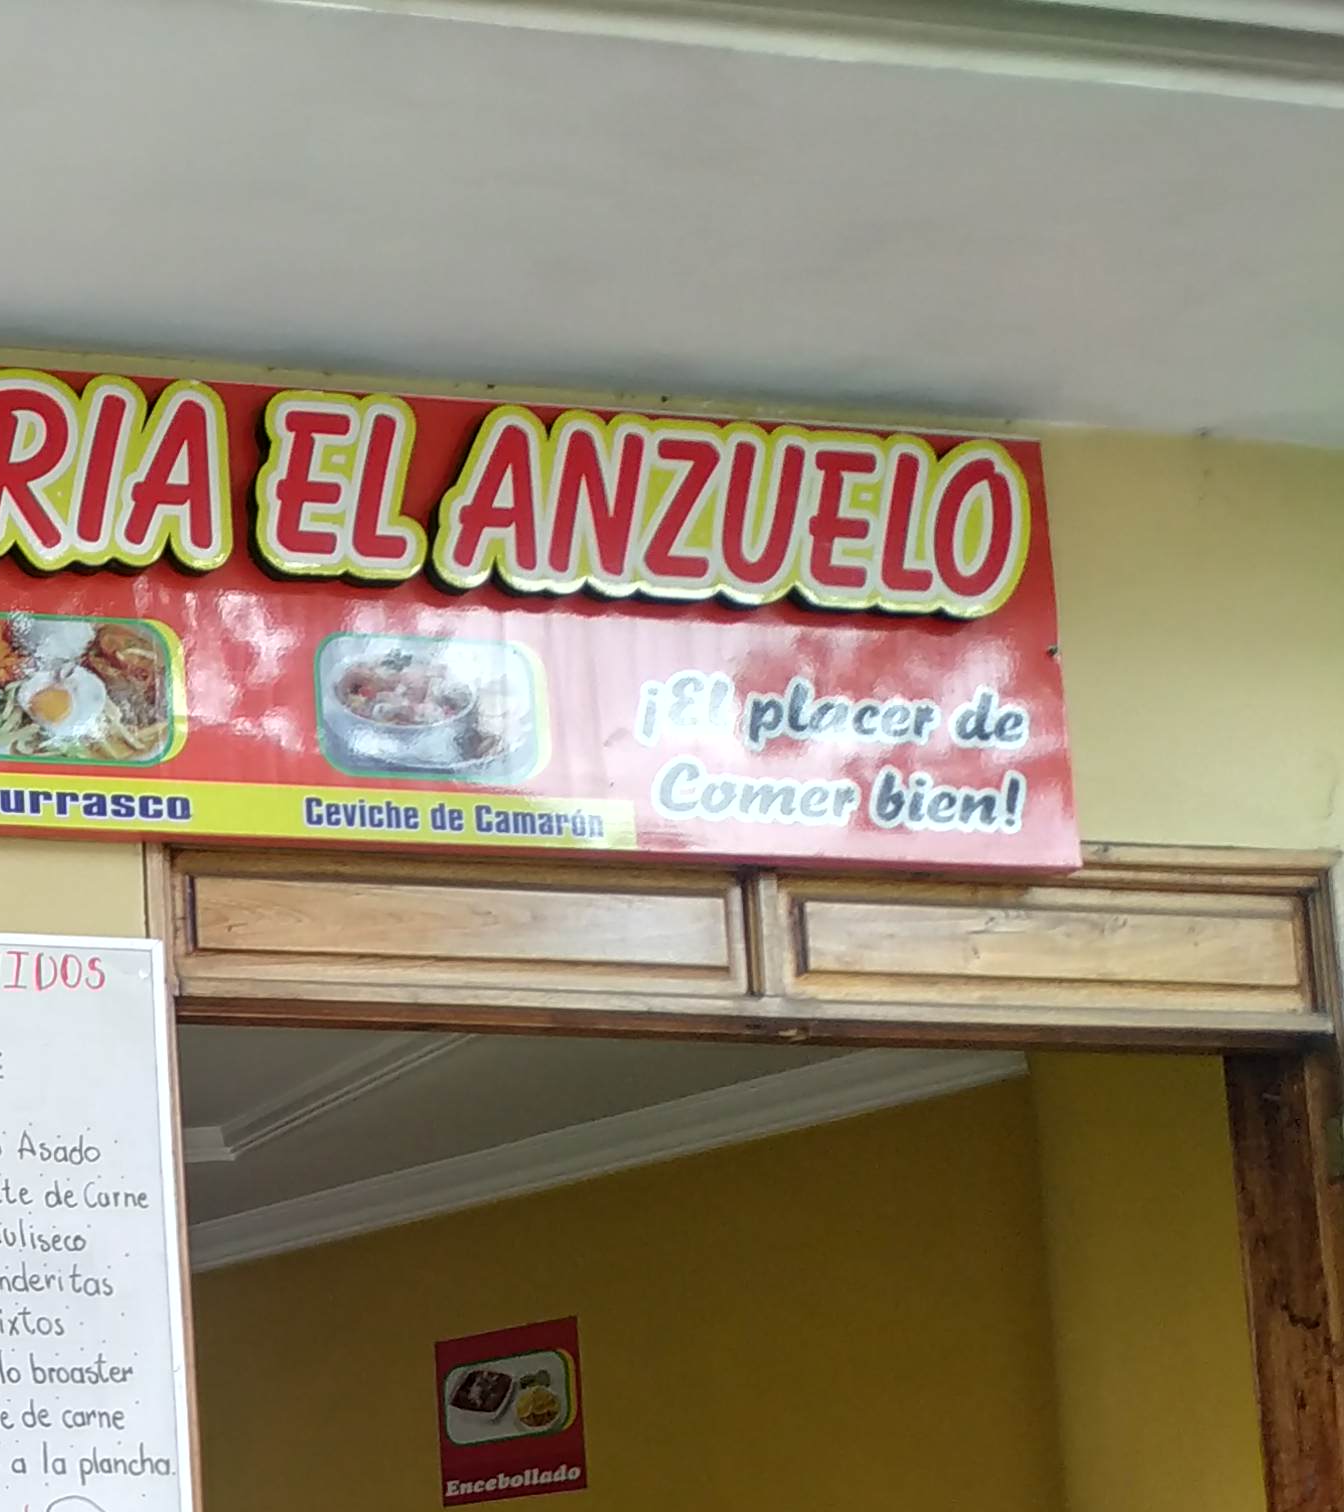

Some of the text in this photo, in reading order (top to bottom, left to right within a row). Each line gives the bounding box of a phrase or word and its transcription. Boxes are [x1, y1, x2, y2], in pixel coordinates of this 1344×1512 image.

[257, 400, 419, 570] EL
[442, 410, 1024, 607] ANZUELO
[749, 690, 944, 753] placer
[954, 700, 1027, 748] de
[654, 762, 1025, 832] Comer bien!
[304, 796, 605, 838] Ceviche de Camarón
[17, 1128, 101, 1165] Asado
[44, 1180, 77, 1208] de
[30, 1353, 134, 1386] broaster
[22, 1398, 51, 1429] de
[62, 1407, 126, 1430] carne
[11, 1459, 27, 1474] a
[43, 1443, 68, 1474] la
[444, 1464, 582, 1497] Encebollado
